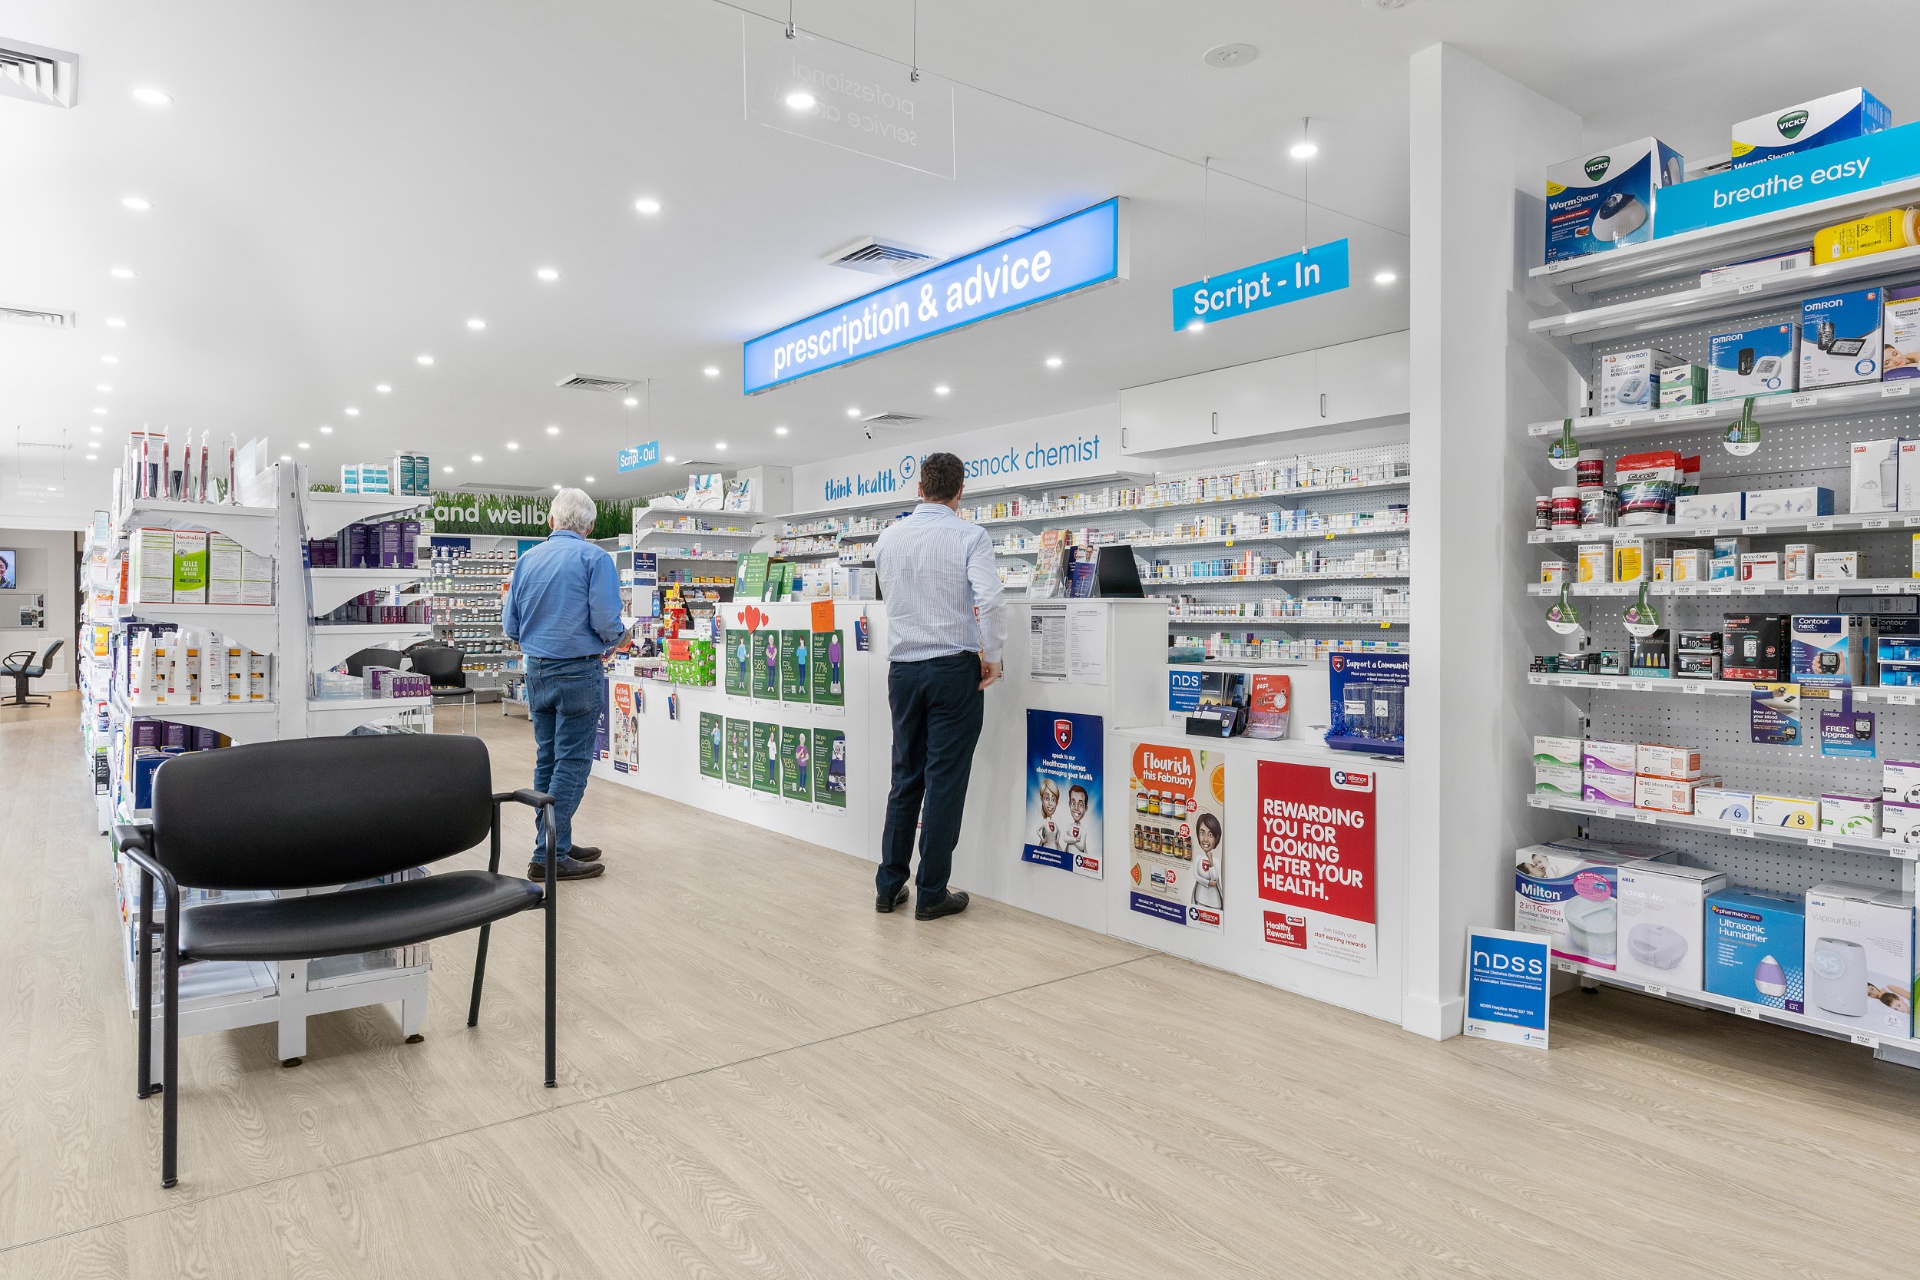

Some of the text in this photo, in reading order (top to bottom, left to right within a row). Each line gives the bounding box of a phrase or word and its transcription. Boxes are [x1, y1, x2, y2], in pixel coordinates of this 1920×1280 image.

[1778, 116, 1807, 131] VICKS
[1586, 162, 1610, 173] VICKS
[1713, 156, 1871, 209] breathe easy
[1193, 279, 1272, 316] Script
[1294, 260, 1321, 289] In
[1804, 299, 1843, 312] OMRON
[773, 249, 1052, 379] prescription & advice
[1712, 333, 1743, 344] OMRON
[1625, 352, 1648, 361] OMRON
[620, 452, 639, 468] Script
[643, 446, 656, 462] Out
[963, 446, 1020, 479] ssnock
[1025, 434, 1100, 470] chemist
[825, 468, 896, 501] think health
[434, 501, 480, 523] and
[486, 504, 551, 526] wellb
[1346, 659, 1371, 669] Support
[1630, 668, 1644, 676] 100
[1822, 731, 1854, 740] Upgrade
[1042, 759, 1086, 772] Healthcare Heroes
[1143, 751, 1191, 777] Flourish
[1048, 769, 1068, 778] managing
[1142, 770, 1194, 789] this February
[1348, 774, 1367, 784] alliance
[1263, 798, 1365, 829] REWARDING
[1733, 808, 1741, 818] 6
[1797, 814, 1805, 825] 8
[1263, 816, 1337, 844] YOU FOR
[1263, 834, 1340, 863] LOOKING
[1263, 854, 1363, 889] AFTER YOUR
[1263, 872, 1329, 901] HEALTH.
[1521, 882, 1563, 900] Milton
[1537, 905, 1561, 916] Combi
[1539, 912, 1556, 921] Starter
[1719, 909, 1761, 921] pharmacycare
[1266, 920, 1292, 934] Healthy
[1719, 918, 1766, 935] Ultrasonic
[1811, 913, 1862, 928] VapourMist
[1267, 929, 1295, 941] Rewards
[1326, 935, 1344, 944] earning
[1344, 938, 1367, 949] rewards
[1719, 927, 1769, 944] Humidifier
[1480, 977, 1499, 985] Australian
[1500, 980, 1525, 988] Government
